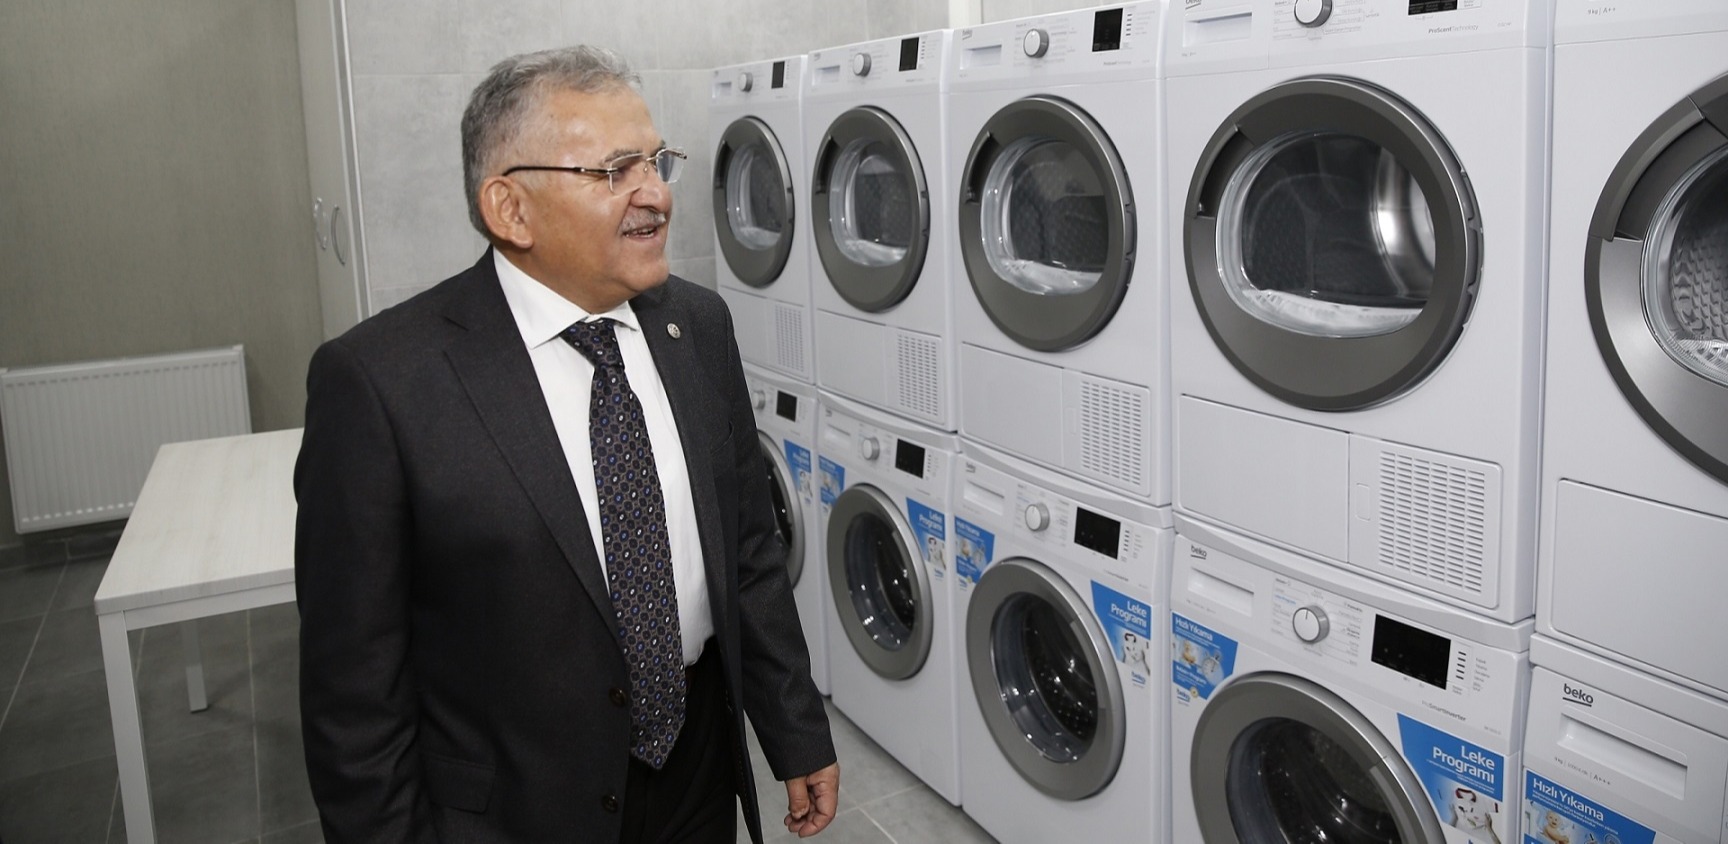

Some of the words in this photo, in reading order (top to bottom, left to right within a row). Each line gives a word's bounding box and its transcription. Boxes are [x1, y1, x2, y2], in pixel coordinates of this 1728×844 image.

[1191, 544, 1207, 558] beko
[1127, 600, 1147, 618] Leke
[1562, 683, 1594, 705] beko
[1432, 746, 1495, 784] Programı
[1461, 745, 1495, 771] Leke
[1533, 777, 1558, 798] Hızlı
[1559, 790, 1604, 822] Yıkama
